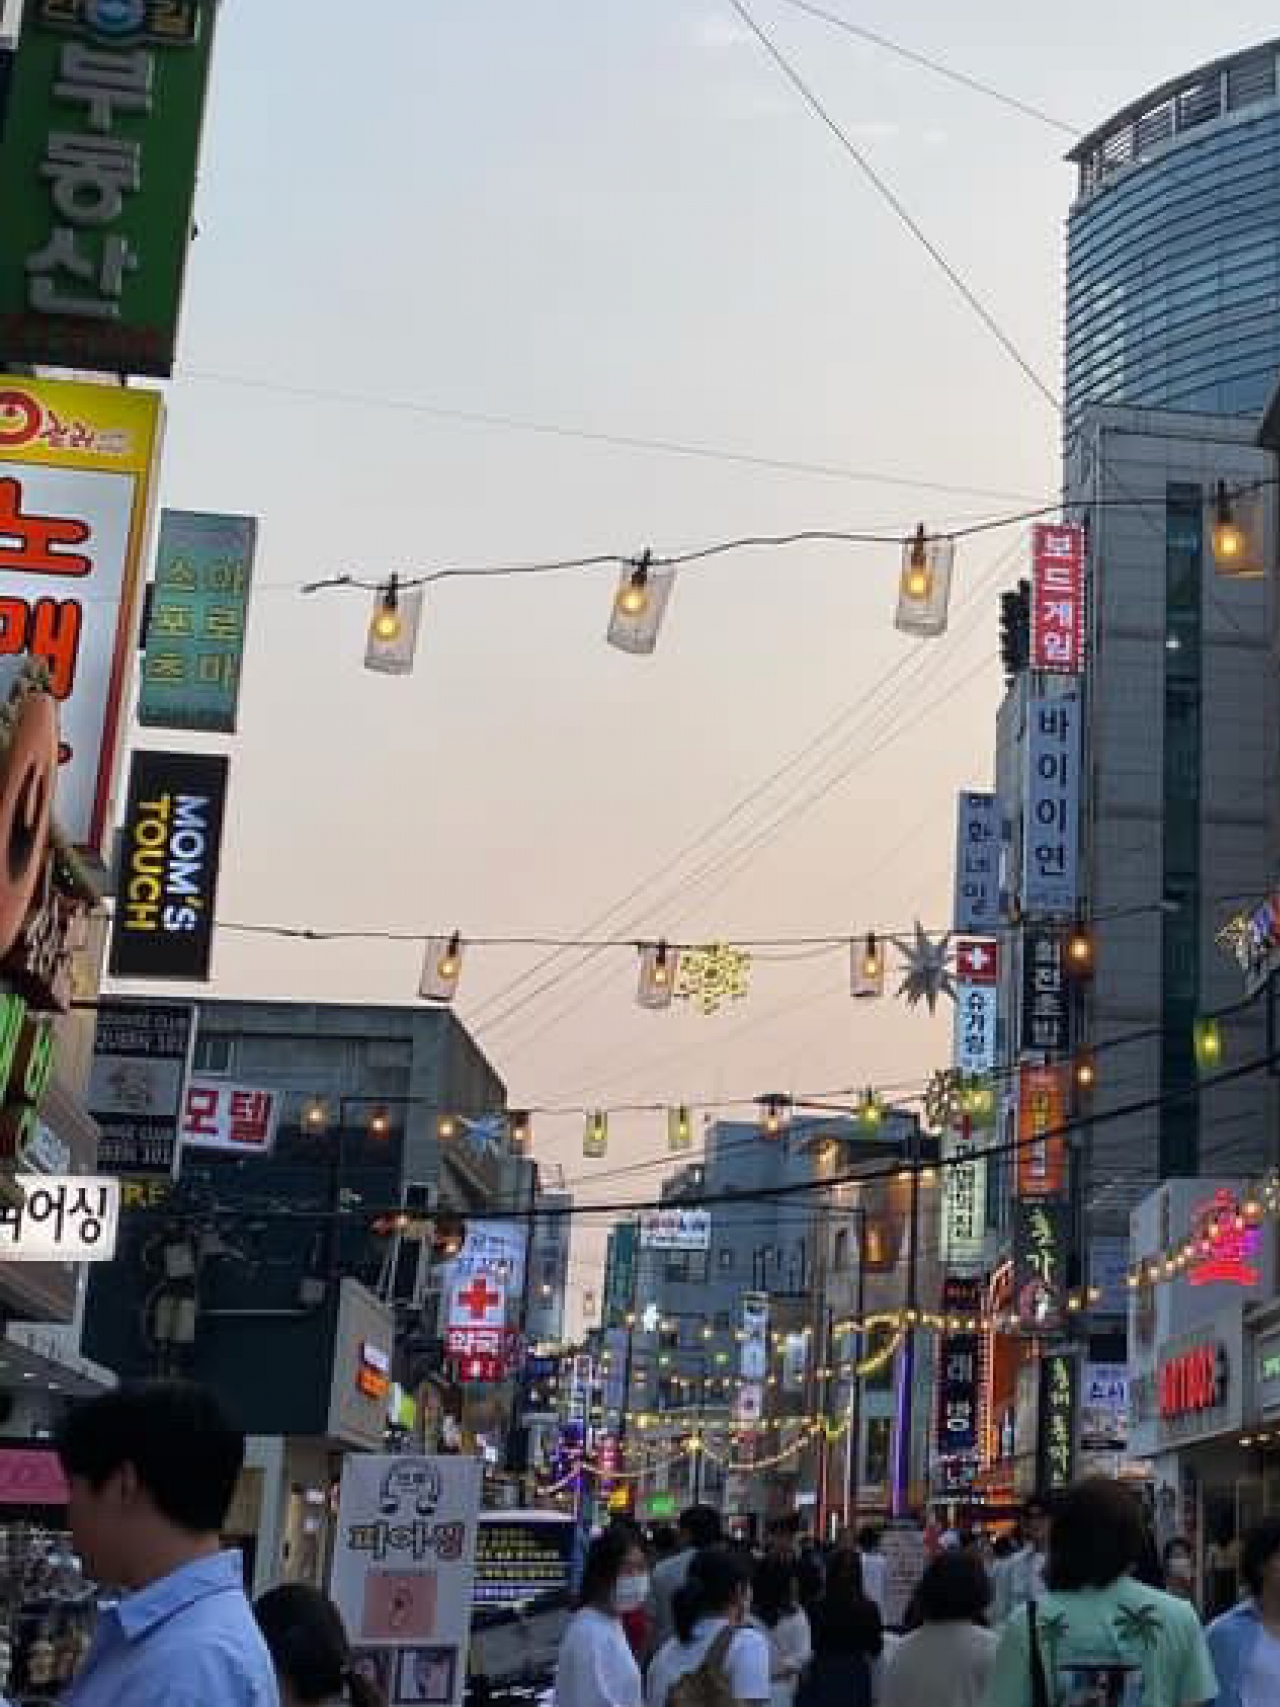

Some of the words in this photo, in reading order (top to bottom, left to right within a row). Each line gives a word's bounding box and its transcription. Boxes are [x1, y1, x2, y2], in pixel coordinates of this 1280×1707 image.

[25, 43, 153, 318] 부동산
[122, 793, 172, 931] TOUCH
[163, 796, 210, 931] MOM'S
[183, 1088, 272, 1144] 모텔
